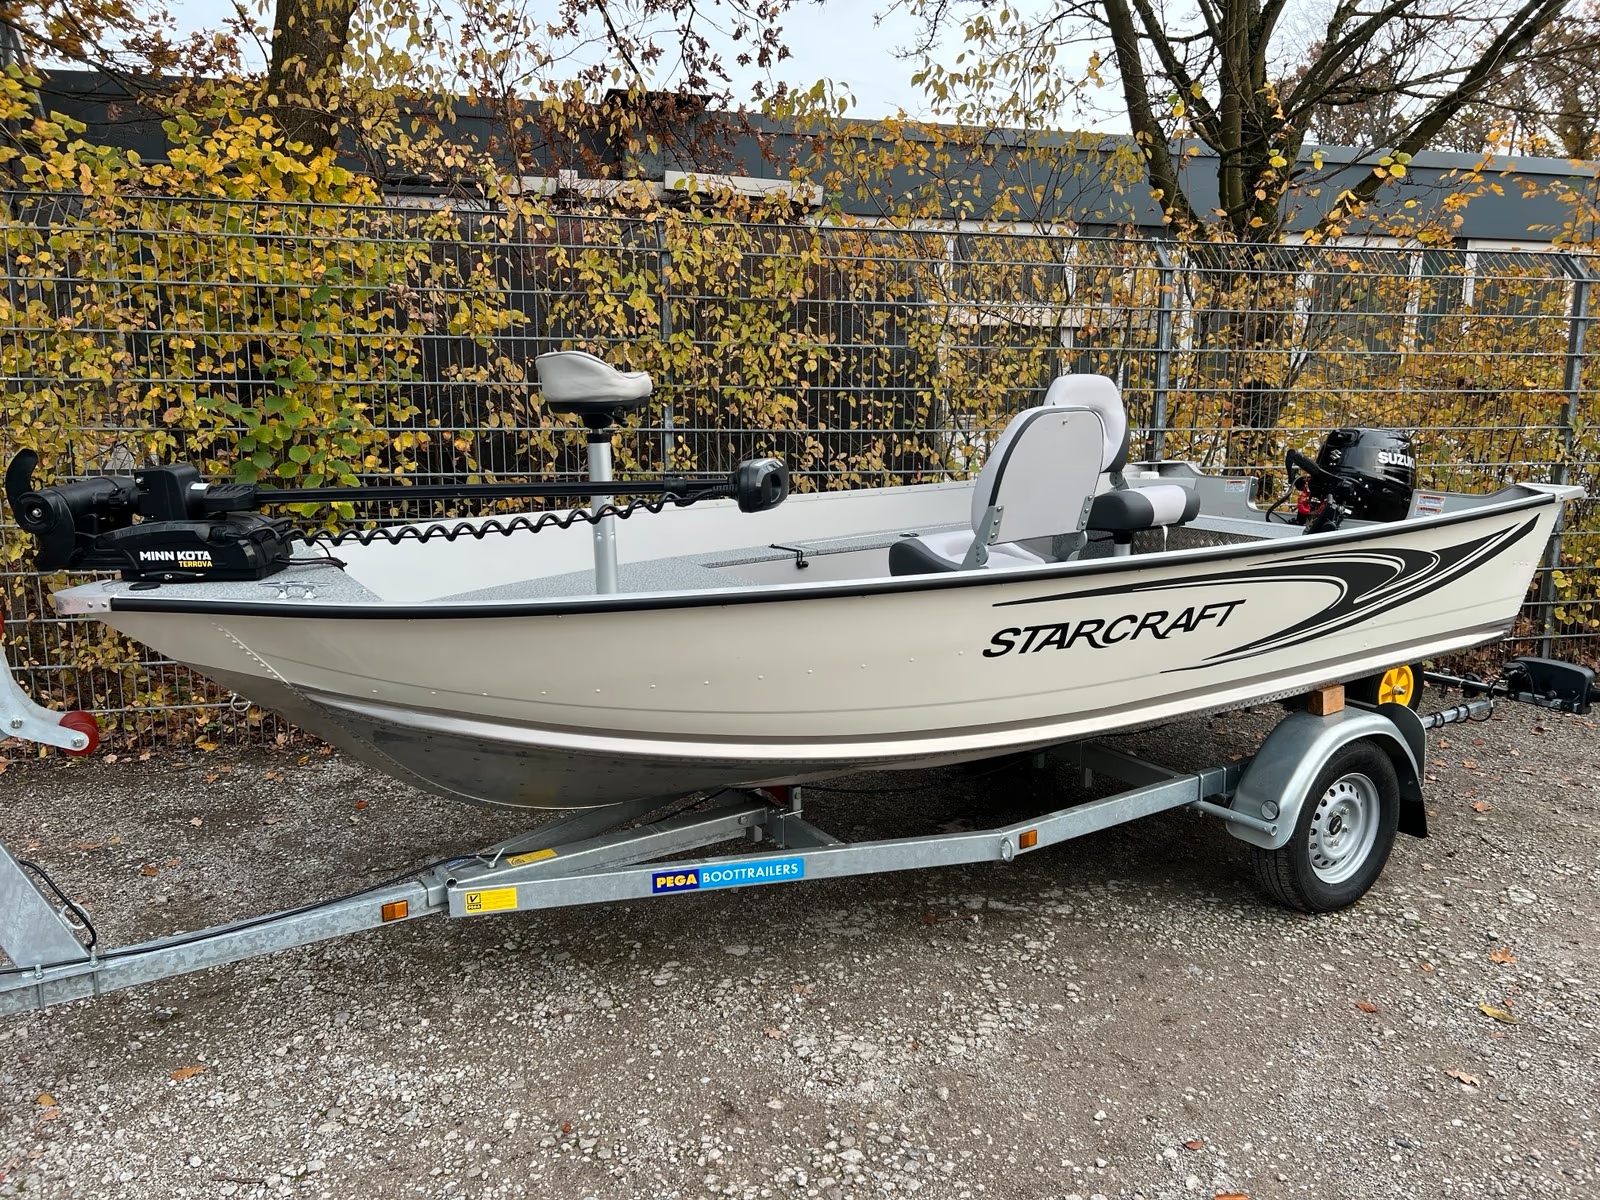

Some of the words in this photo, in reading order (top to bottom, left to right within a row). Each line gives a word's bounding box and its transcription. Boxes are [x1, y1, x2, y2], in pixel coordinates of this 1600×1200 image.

[1377, 451, 1416, 469] SUZUK
[139, 550, 175, 561] MINN
[176, 550, 212, 561] KOTA
[178, 560, 213, 568] TERROVA
[982, 599, 1247, 658] STARCRAFT
[656, 873, 698, 889] PEGA
[702, 863, 799, 883] BOOTTRAILERS
